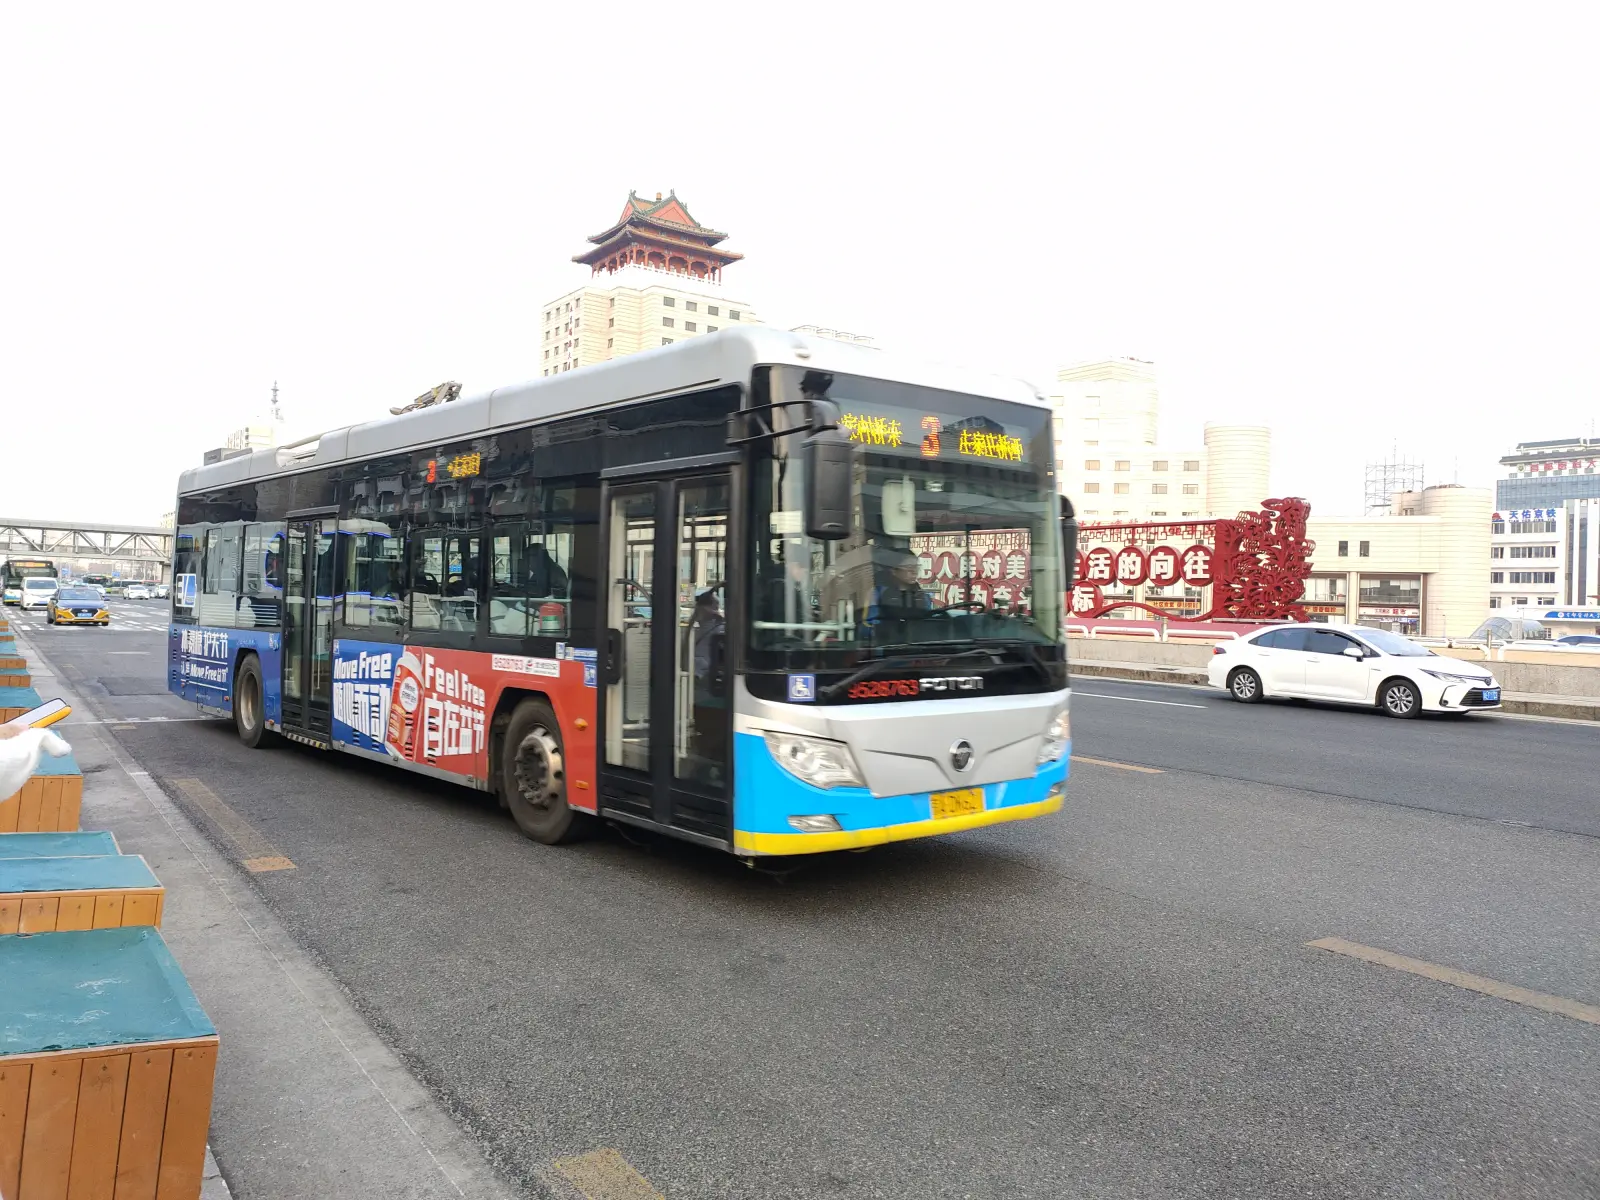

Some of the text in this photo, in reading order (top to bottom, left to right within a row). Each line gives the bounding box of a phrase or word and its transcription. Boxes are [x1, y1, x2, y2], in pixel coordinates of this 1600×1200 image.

[920, 415, 940, 457] 3
[1508, 508, 1557, 520] 天佑京铁
[1074, 550, 1211, 581] 活的向往
[1072, 586, 1095, 611] 标
[333, 651, 392, 679] Move Free
[425, 653, 486, 707] Feel Free
[423, 693, 486, 758] 自在益节
